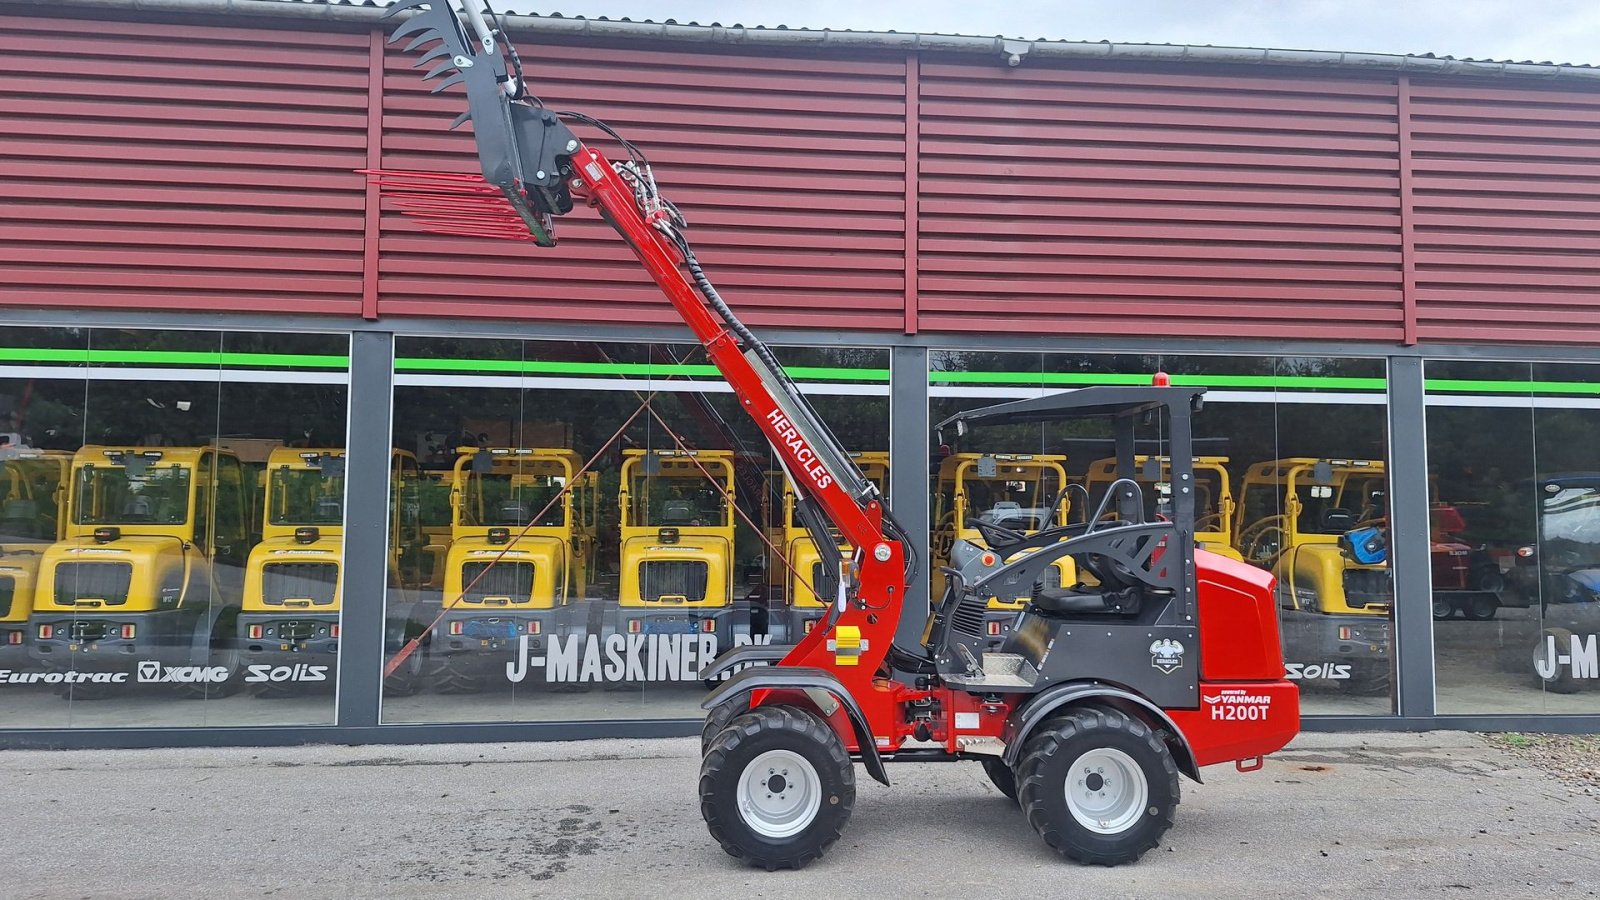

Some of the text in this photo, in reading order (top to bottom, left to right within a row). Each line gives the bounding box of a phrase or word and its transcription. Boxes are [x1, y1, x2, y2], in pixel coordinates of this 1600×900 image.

[767, 408, 832, 489] HERACLES
[0, 669, 129, 683] Eurotrac
[159, 666, 229, 683] XCMG
[1221, 695, 1271, 704] YANMAR
[1211, 705, 1270, 721] H200T
